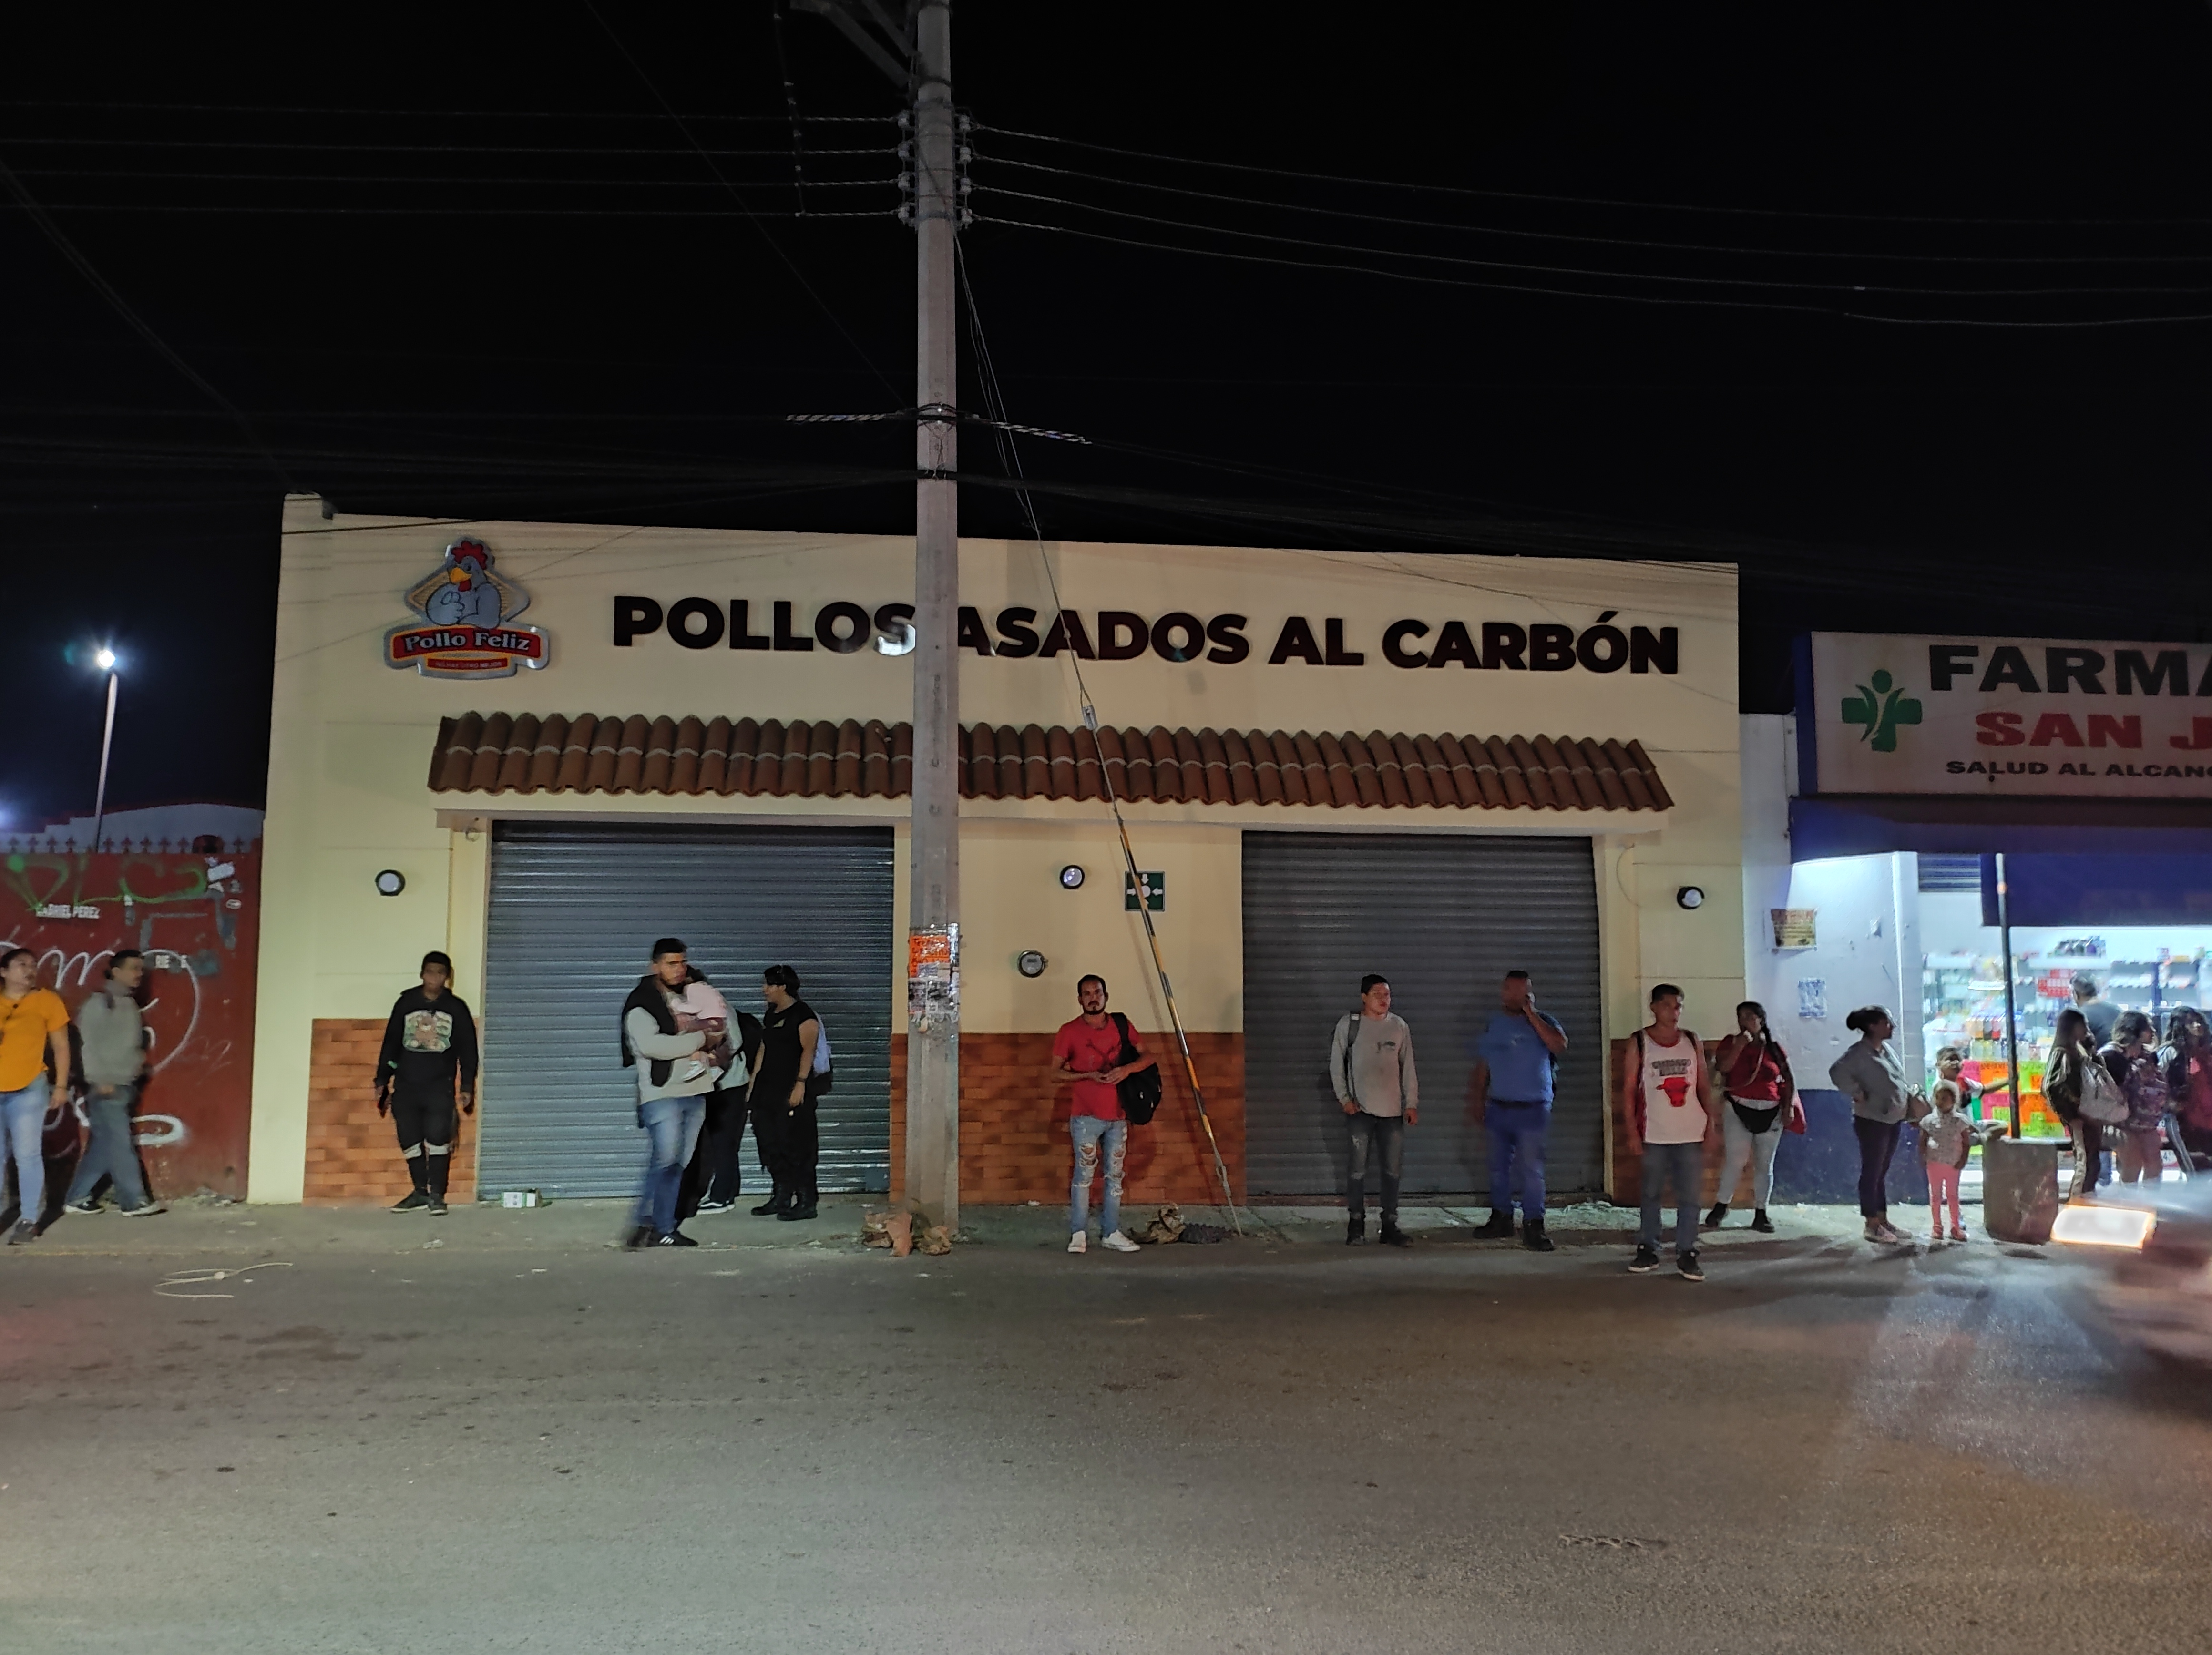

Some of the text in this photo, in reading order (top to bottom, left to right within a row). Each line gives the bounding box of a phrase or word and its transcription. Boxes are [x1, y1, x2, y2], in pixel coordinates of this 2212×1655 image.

[405, 632, 531, 651] Pollo Feliz
[614, 596, 1679, 674] POLLOS ASADOS AL CARBÓN
[1929, 645, 2212, 696] FARM
[1976, 712, 2142, 748] SAN
[1946, 761, 2048, 775] SALUD
[2058, 763, 2096, 776] AL
